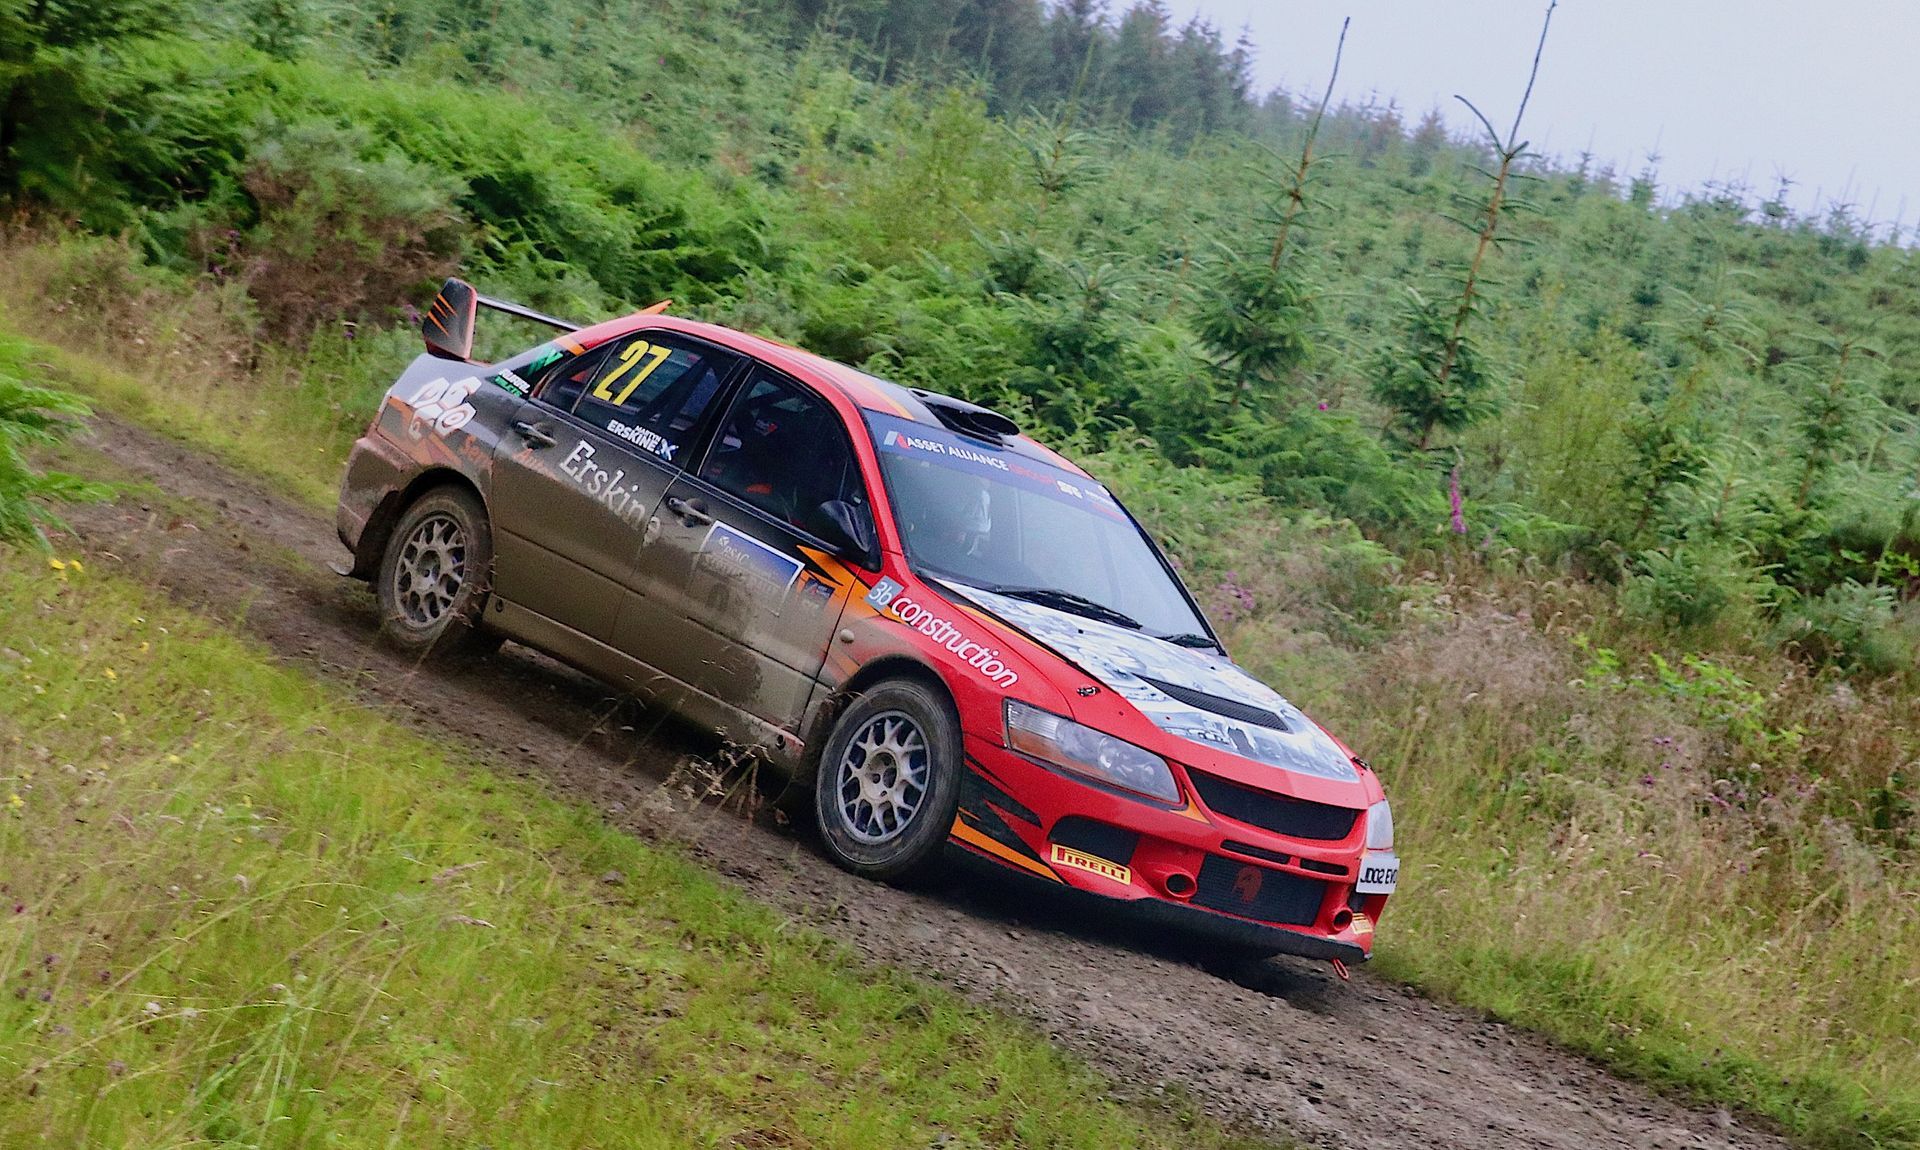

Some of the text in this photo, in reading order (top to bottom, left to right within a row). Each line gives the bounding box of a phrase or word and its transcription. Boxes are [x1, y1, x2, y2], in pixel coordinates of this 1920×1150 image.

[592, 340, 672, 407] 27
[606, 419, 660, 453] ERSKINE
[907, 437, 1009, 471] ASSET ALLIANCE
[868, 581, 892, 606] 3b
[891, 597, 1018, 688] construction
[1056, 846, 1127, 881] PIRELLI
